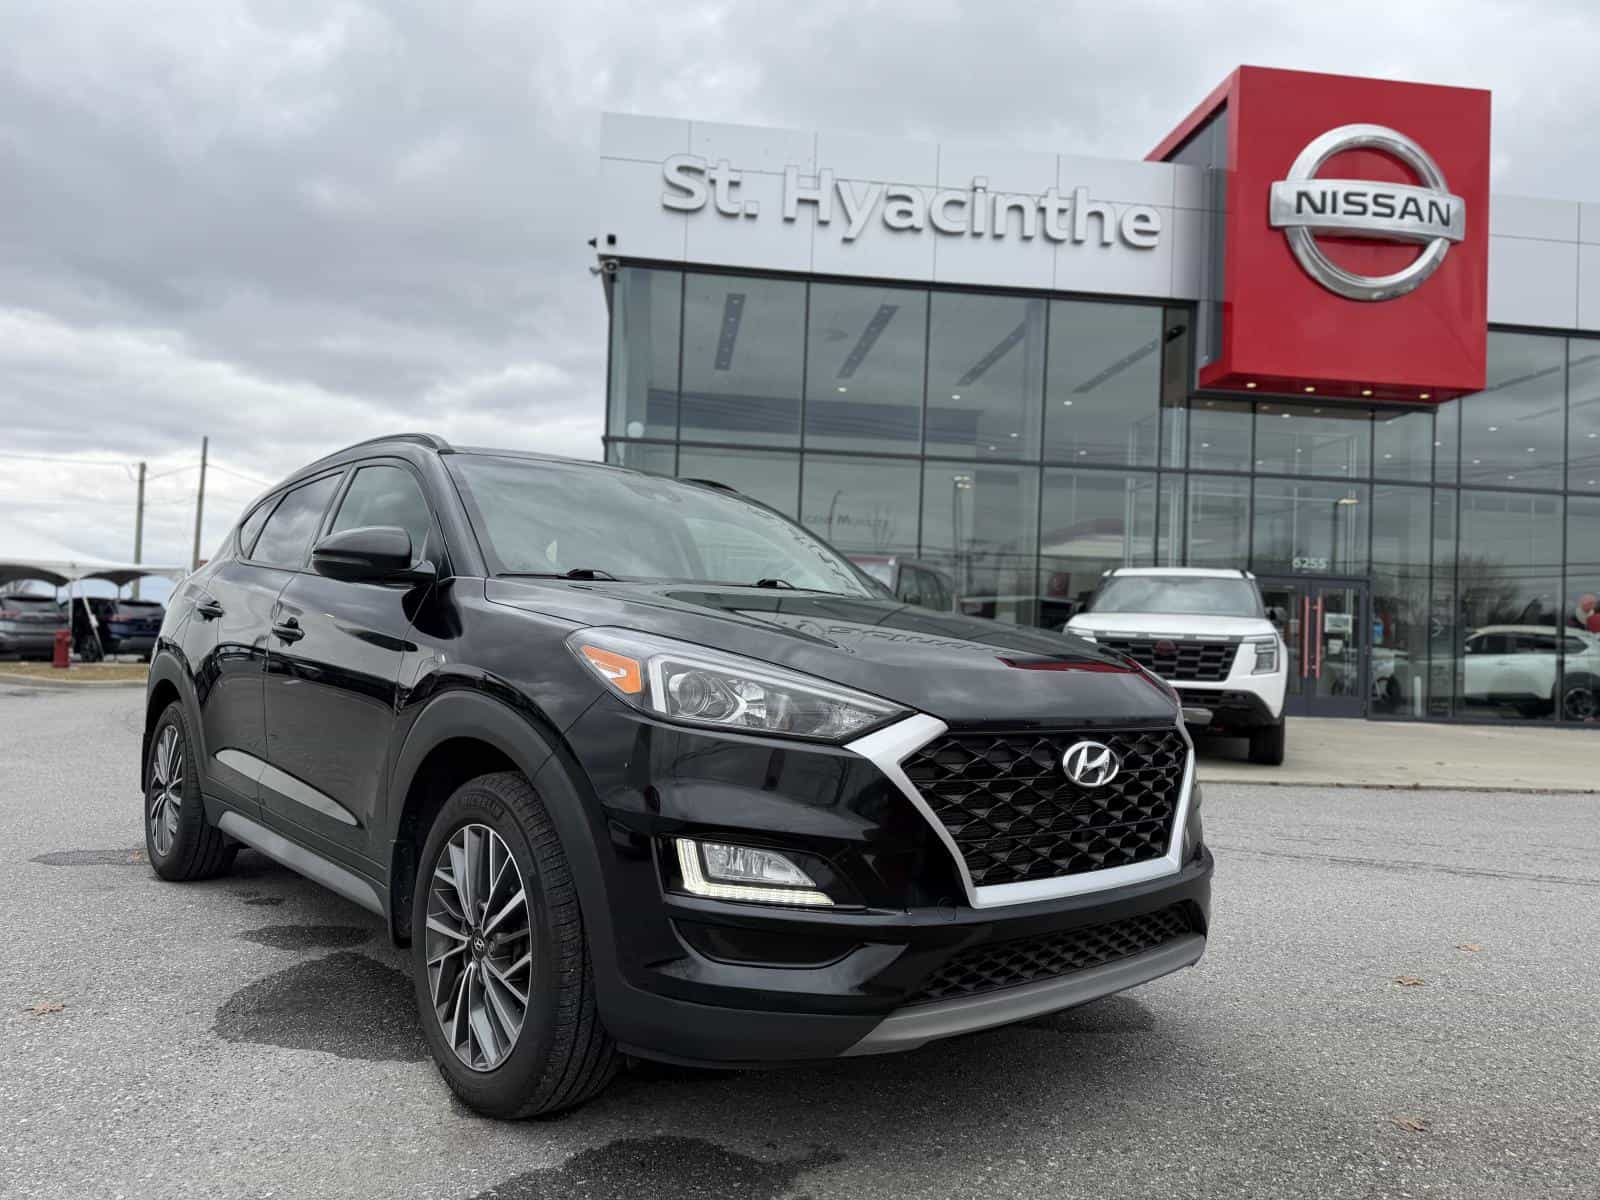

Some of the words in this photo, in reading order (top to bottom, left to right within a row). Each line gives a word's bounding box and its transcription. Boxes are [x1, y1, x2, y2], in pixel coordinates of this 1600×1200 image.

[663, 153, 759, 219] St.
[783, 165, 1161, 250] Hyacinthe
[1296, 190, 1450, 226] NISSAN
[1292, 557, 1329, 569] 6255
